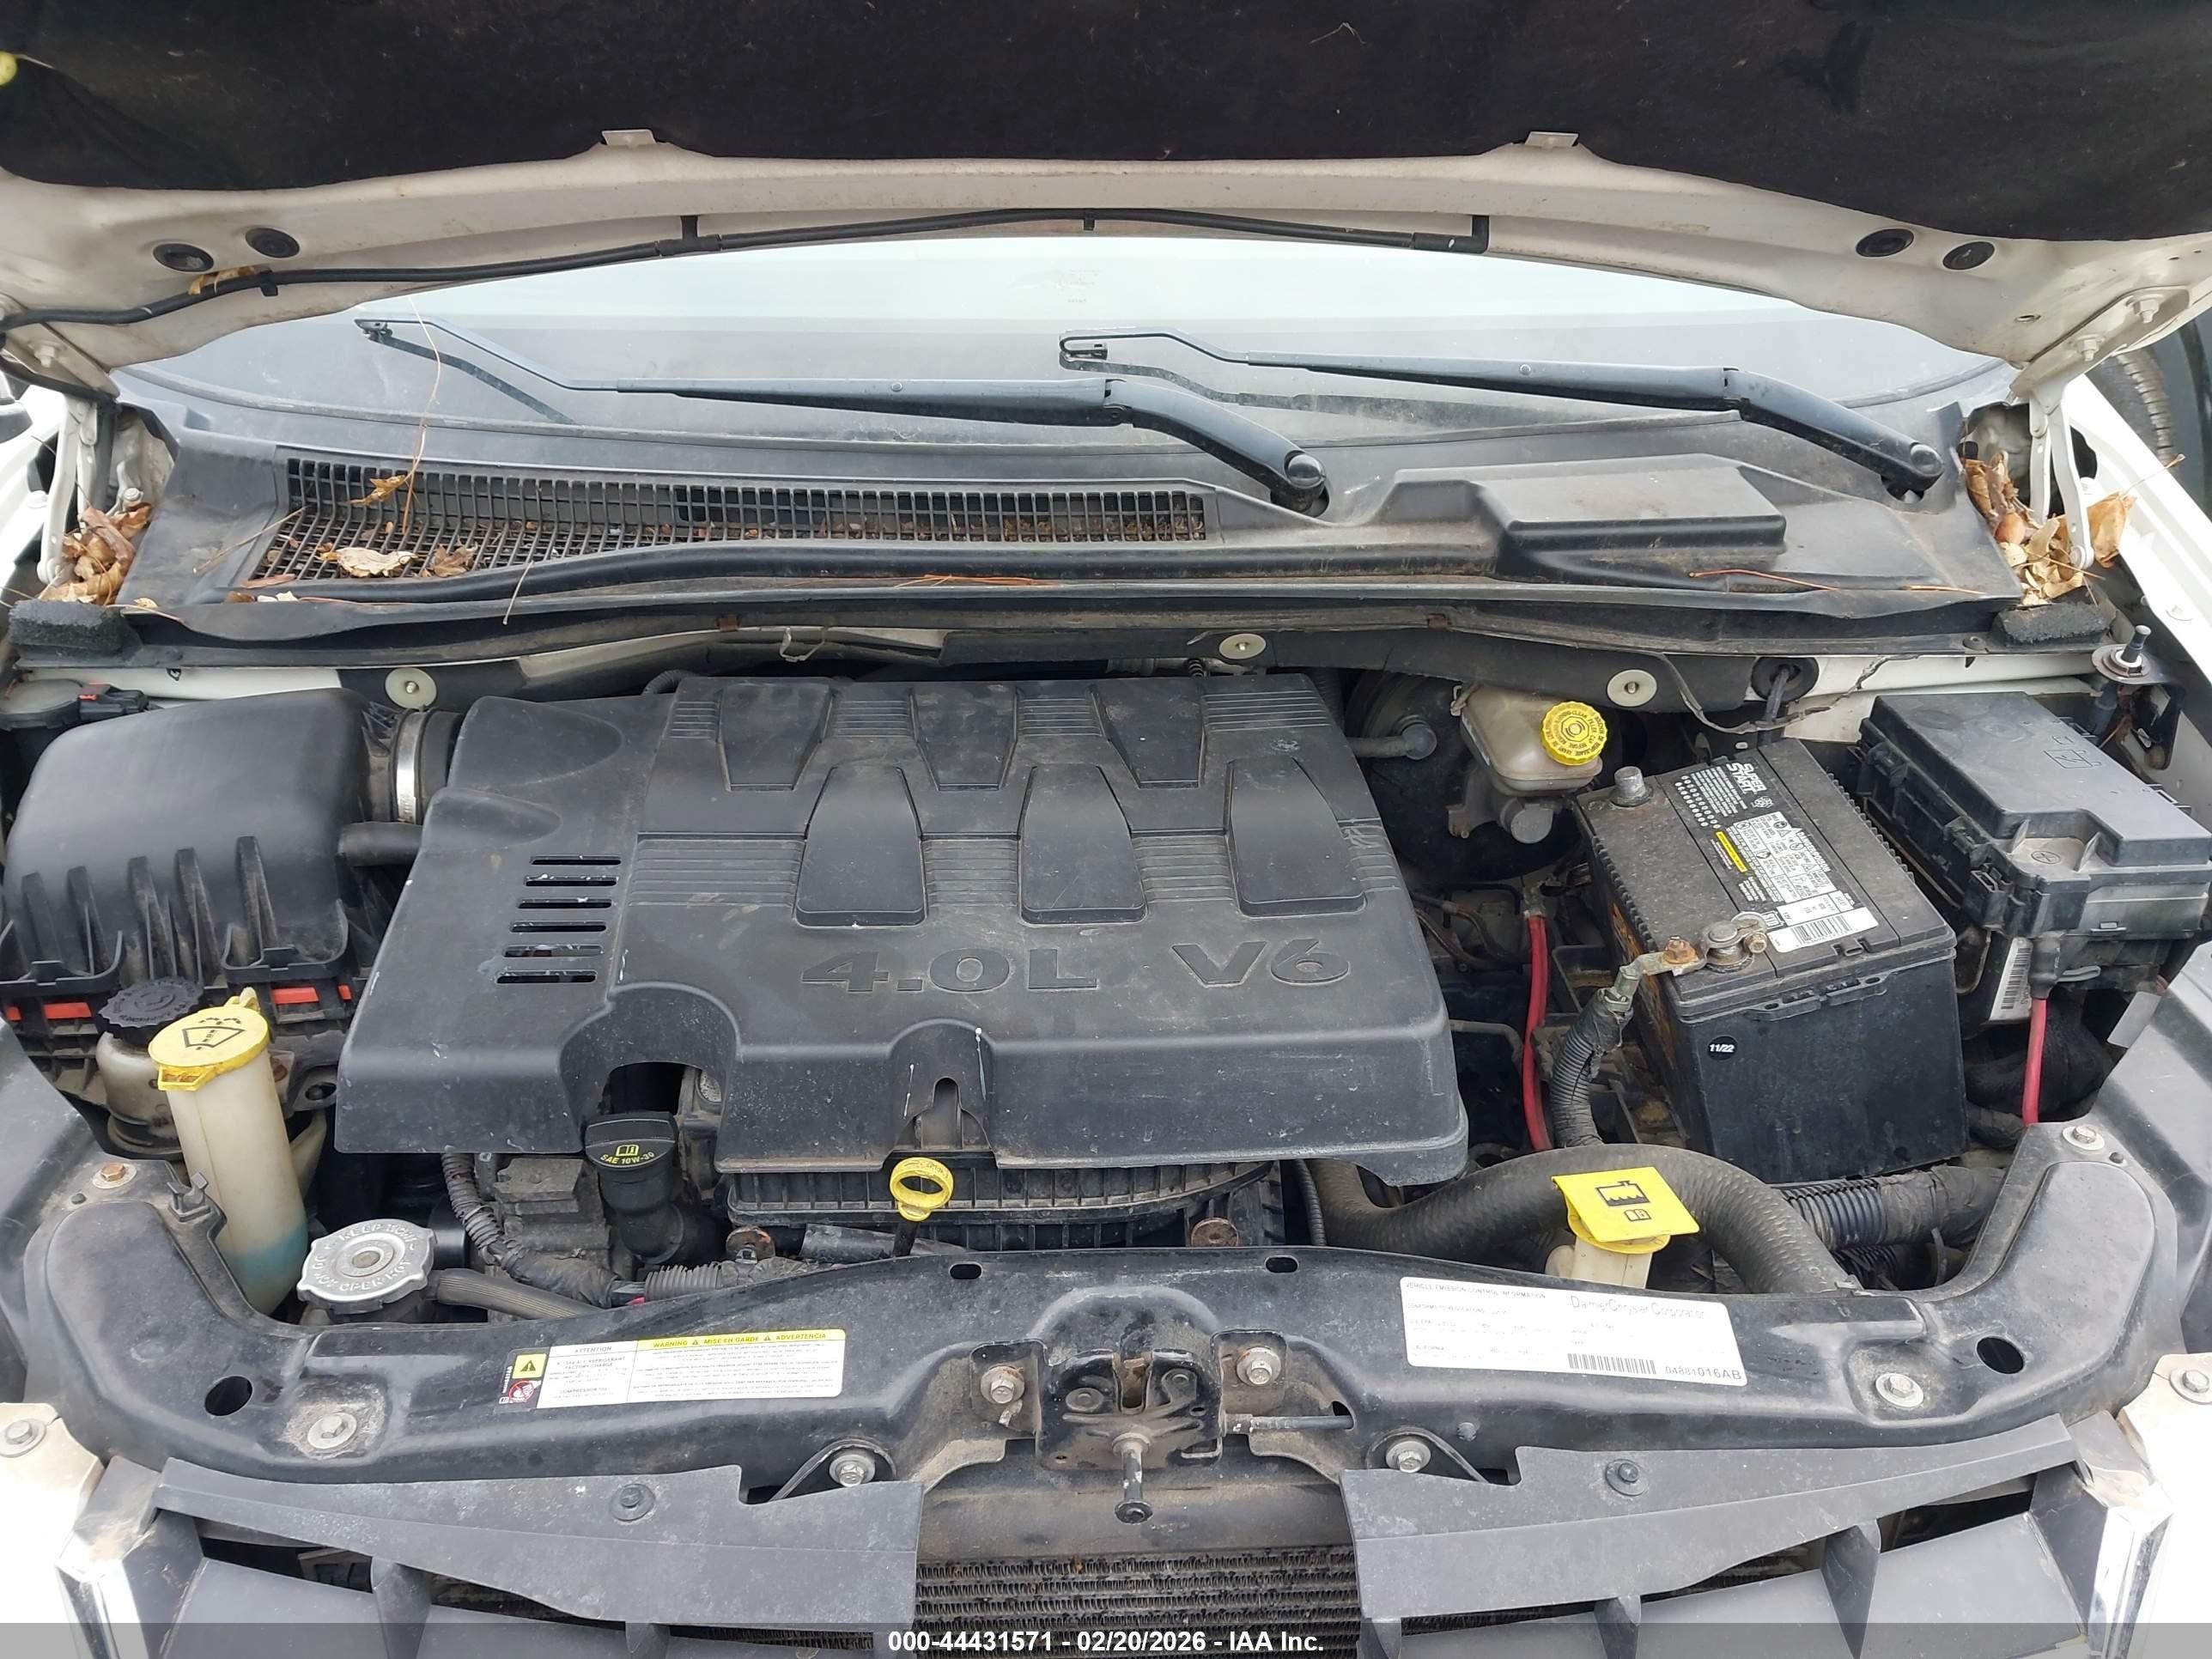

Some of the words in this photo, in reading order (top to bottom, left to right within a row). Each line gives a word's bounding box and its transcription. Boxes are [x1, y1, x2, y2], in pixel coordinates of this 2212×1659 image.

[1725, 761, 1758, 794] START
[1739, 762, 1769, 792] SUPER
[801, 946, 1099, 994] 4.0L
[1170, 938, 1352, 987] V6
[1709, 1043, 1735, 1054] 11/22
[599, 1153, 620, 1164] SAE
[621, 1151, 655, 1165] 10W-30
[338, 1223, 383, 1241] KEEP
[1405, 1281, 1432, 1290] VEHICLE
[653, 1340, 688, 1349] WARNING
[775, 1332, 827, 1341] ADVERTENCIA
[574, 1346, 612, 1354] ATTENTION
